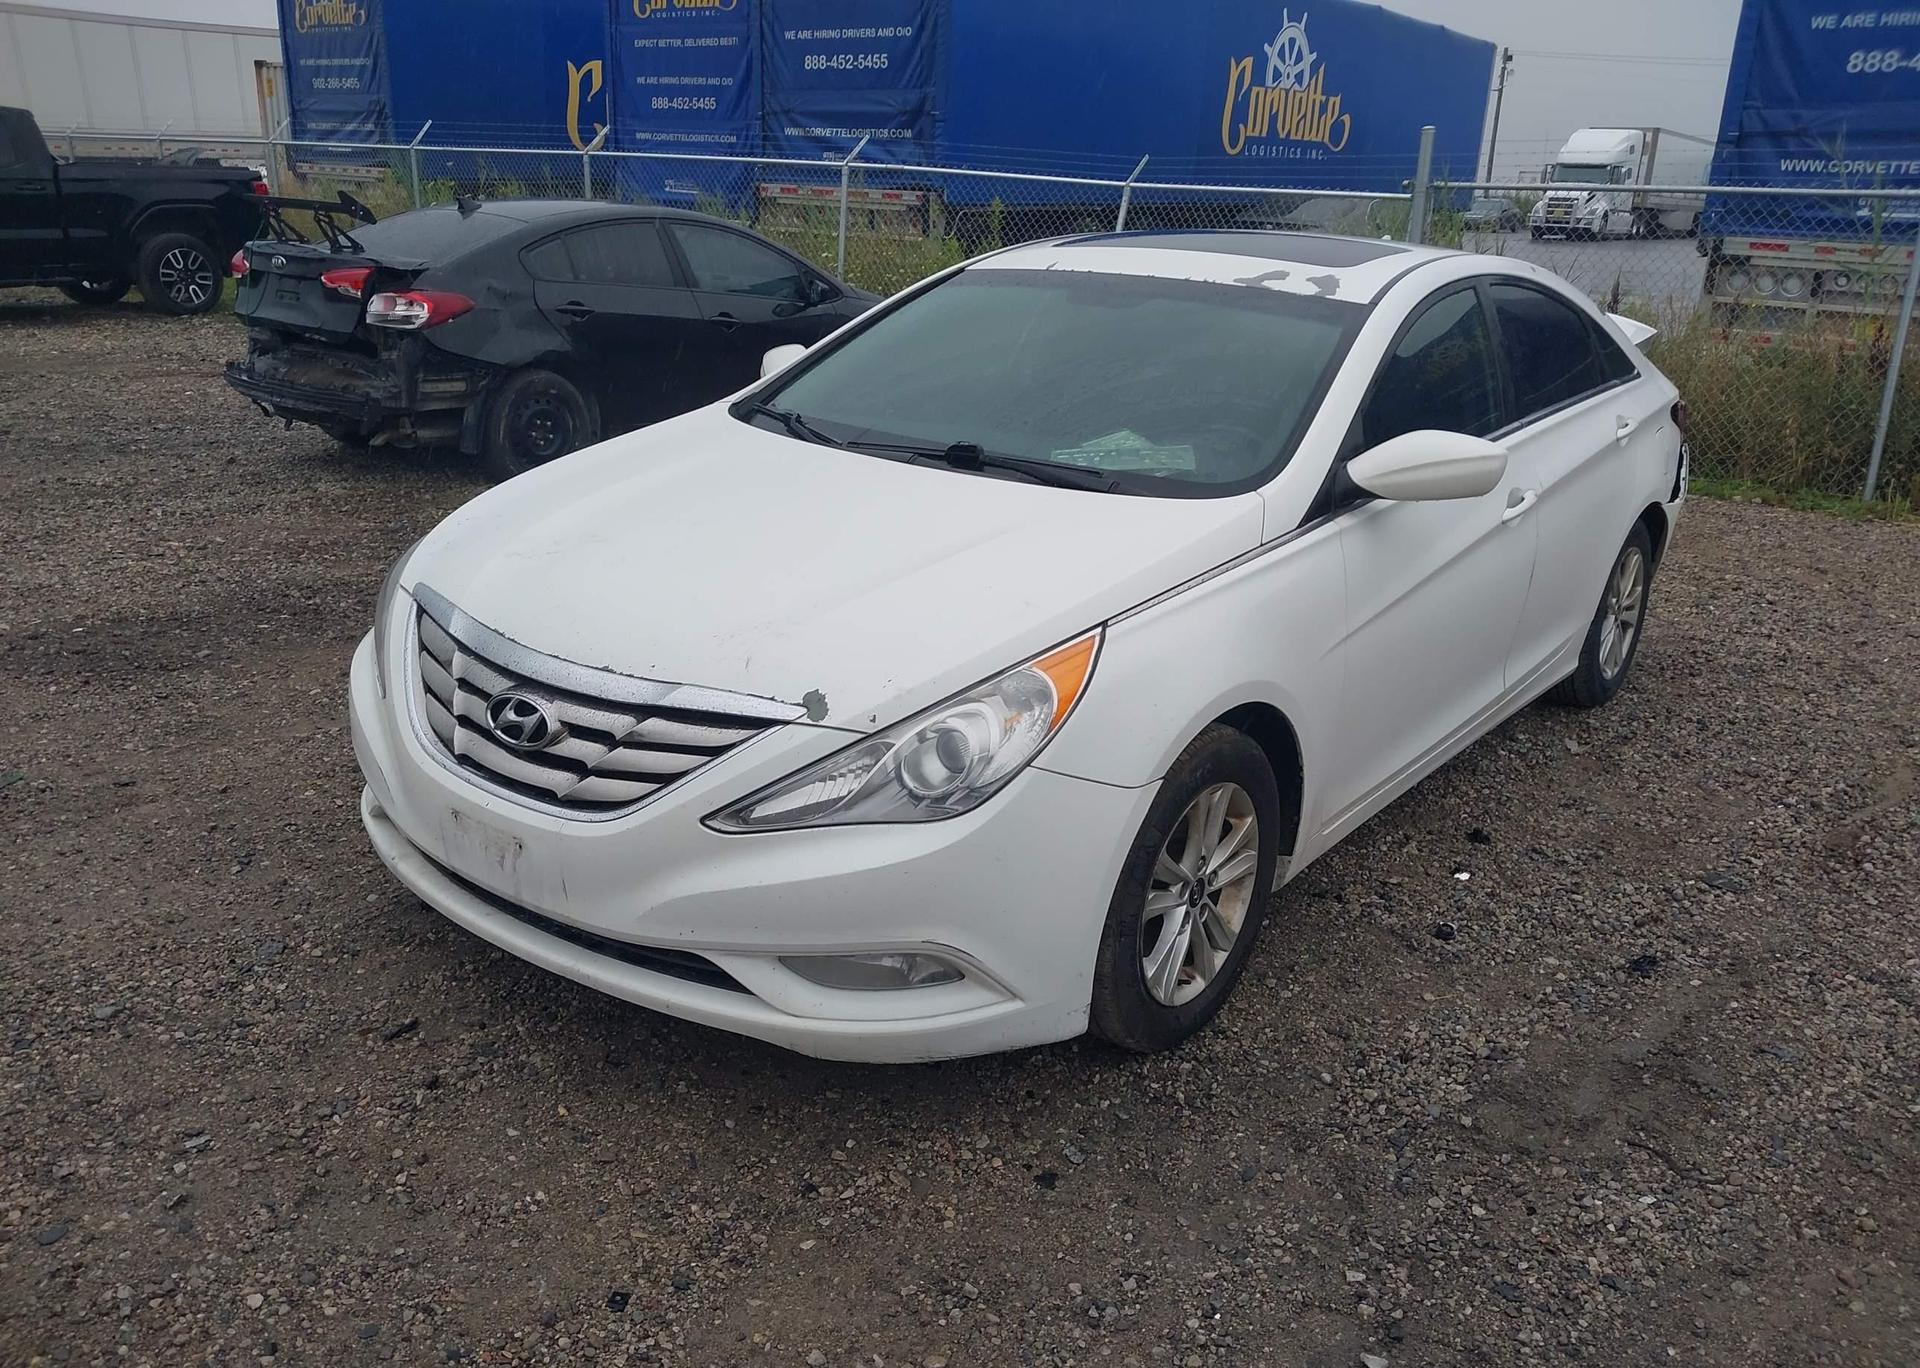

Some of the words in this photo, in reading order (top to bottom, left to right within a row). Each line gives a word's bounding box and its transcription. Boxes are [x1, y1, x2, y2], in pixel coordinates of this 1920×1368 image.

[651, 11, 696, 19] LOGISTICS
[1811, 15, 1838, 29] WE
[1840, 14, 1876, 28] ARE
[784, 30, 796, 40] WE
[797, 30, 813, 39] ARE
[814, 29, 840, 39] HIRING
[842, 28, 876, 38] DRIVERS
[877, 27, 894, 37] AND
[896, 26, 912, 36] O/O
[634, 39, 658, 48] EXPECT
[684, 38, 719, 47] DELIVERED
[804, 53, 889, 70] 888-452-5455
[636, 76, 646, 85] WE
[646, 76, 658, 85] ARE
[659, 76, 679, 85] HIRING
[680, 77, 706, 85] DRIVERS
[707, 77, 720, 86] AND
[651, 97, 717, 110] 888-452-5455
[1221, 56, 1351, 155] Corvette
[636, 132, 737, 143] WWW.CORVETTELOGISTICS.COM
[784, 127, 912, 139] WWW.CORVETTELOGISTICS.COM
[1245, 144, 1301, 159] LOGISTICS
[1306, 148, 1328, 160] INC.
